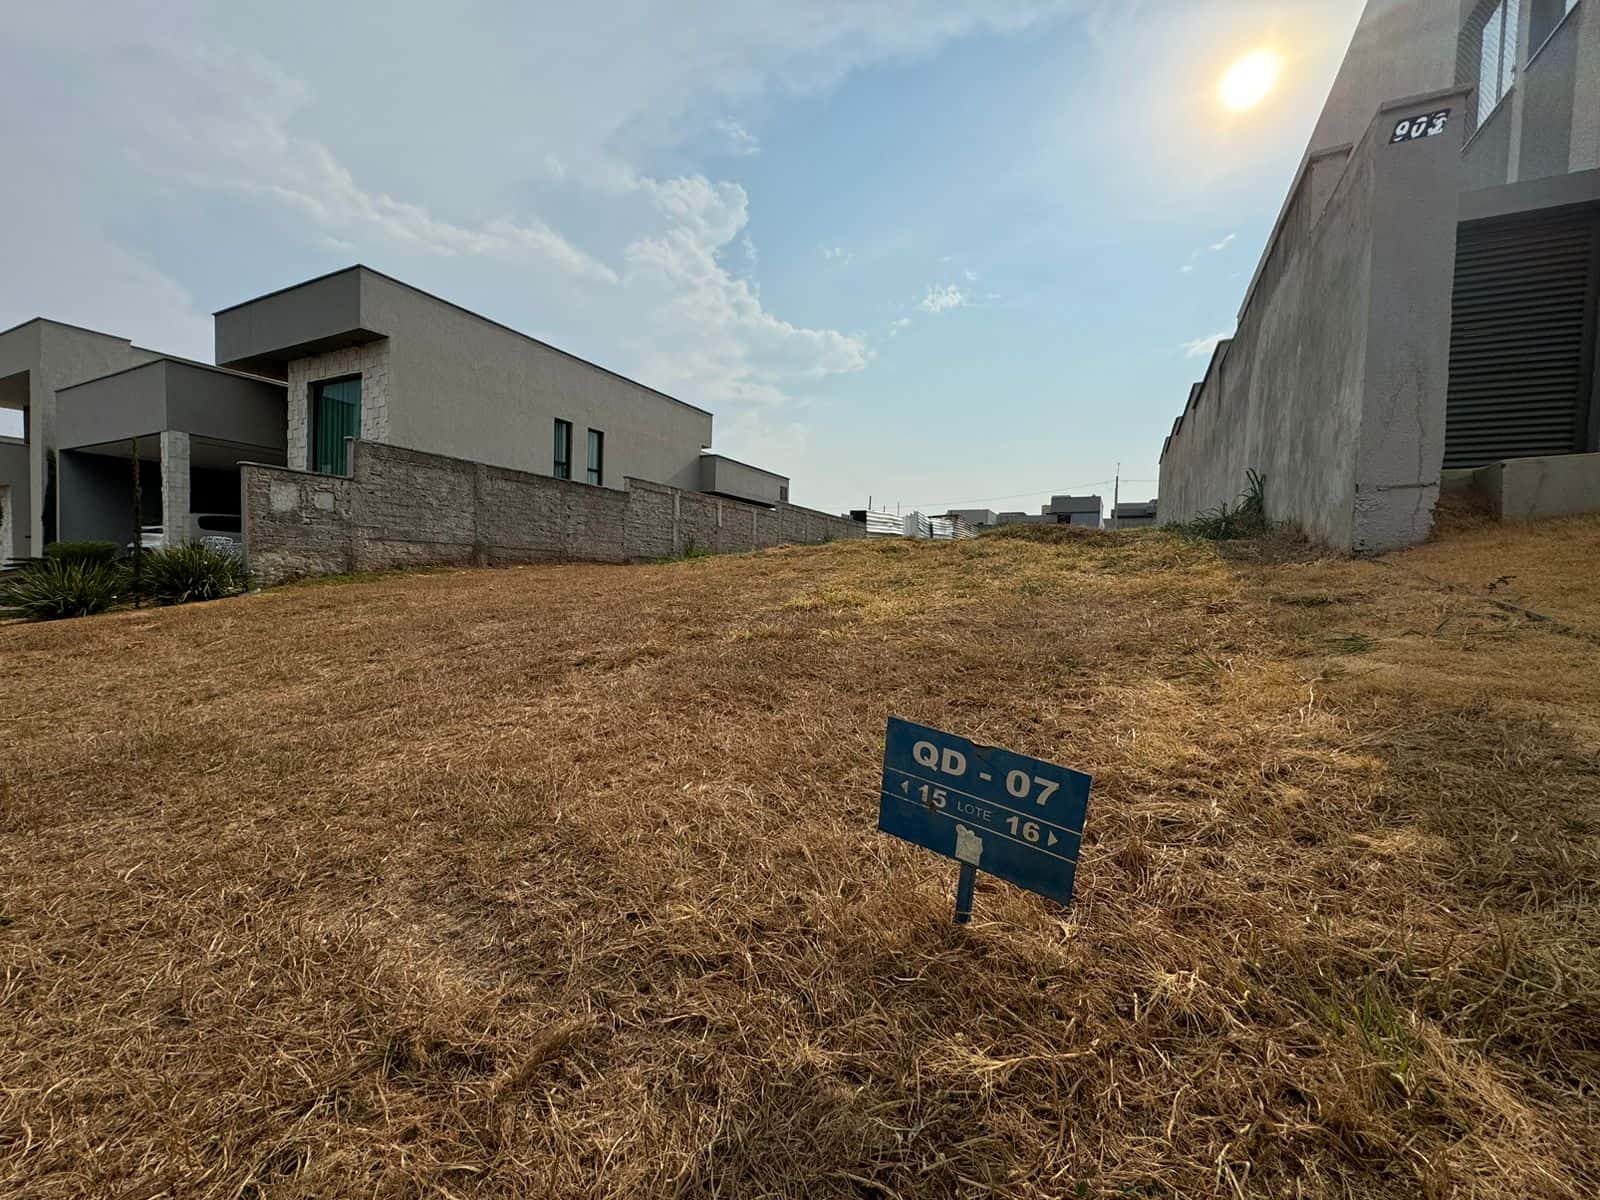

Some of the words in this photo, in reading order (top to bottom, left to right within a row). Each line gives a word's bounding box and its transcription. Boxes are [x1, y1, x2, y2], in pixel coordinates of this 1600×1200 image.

[912, 740, 967, 777] QD
[1005, 769, 1061, 806] 07
[918, 784, 948, 809] 15
[956, 800, 993, 822] LOTE
[1005, 815, 1041, 842] 16
